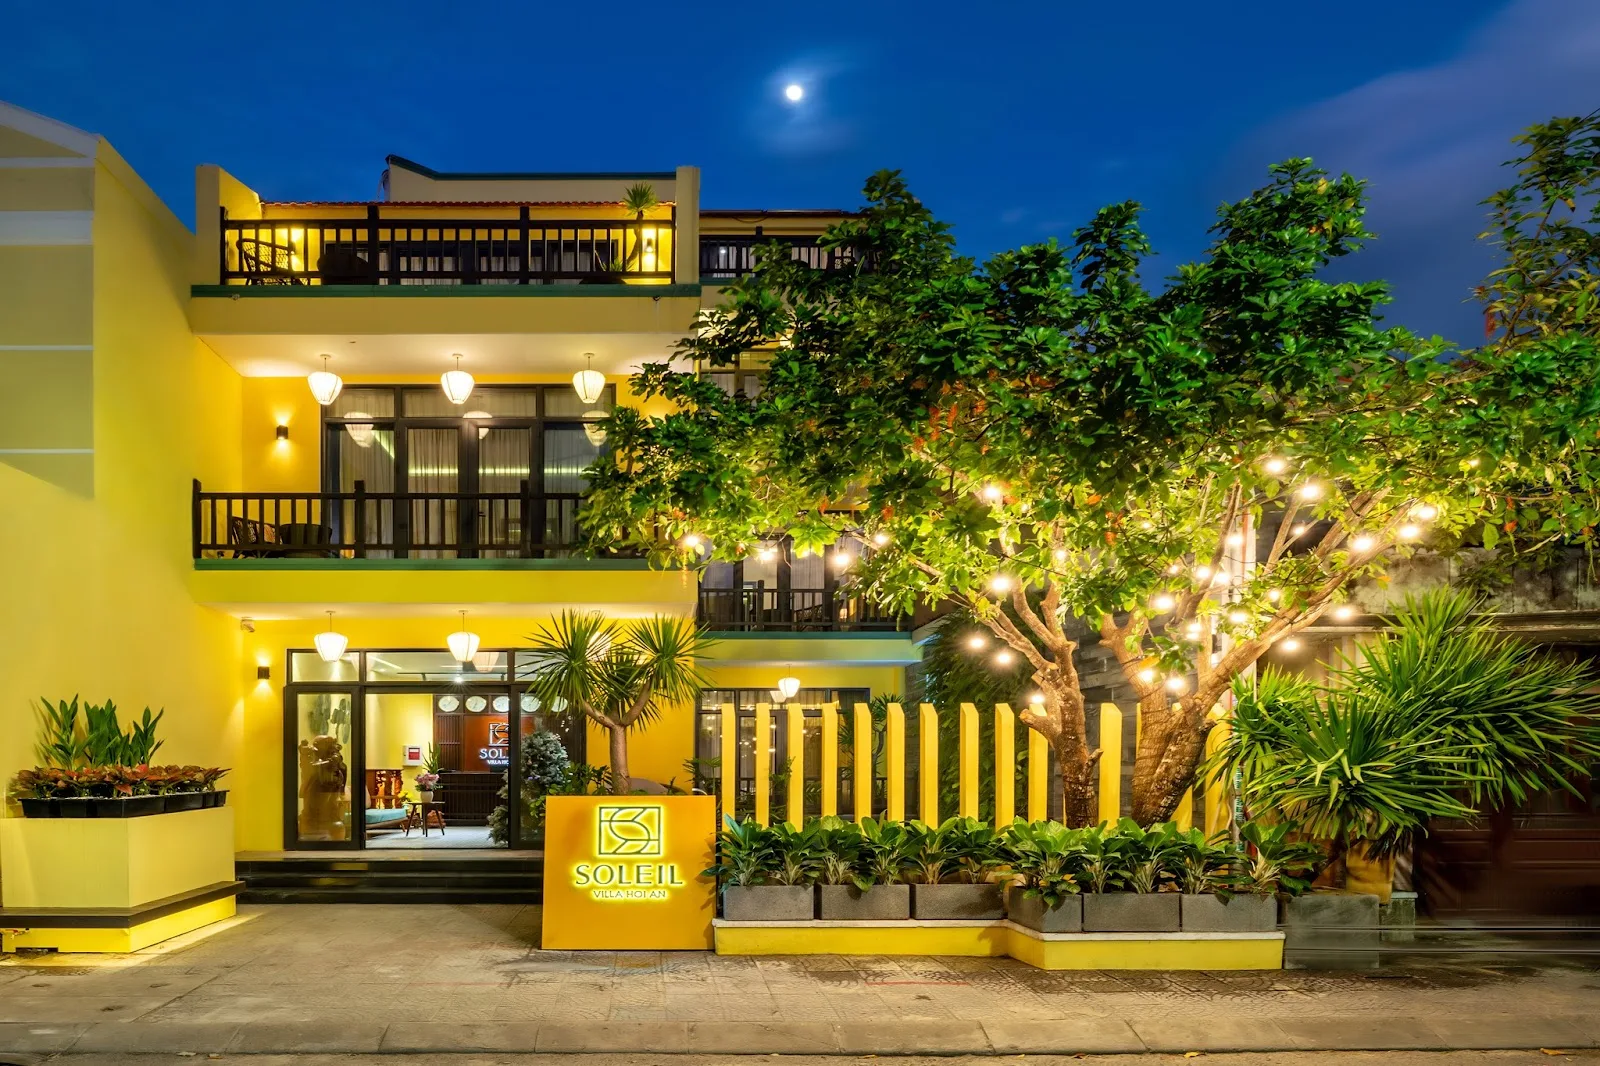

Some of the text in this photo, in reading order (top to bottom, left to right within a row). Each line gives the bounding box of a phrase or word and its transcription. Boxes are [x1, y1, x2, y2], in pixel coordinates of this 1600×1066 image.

[479, 748, 509, 760] SOL
[575, 864, 683, 885] SOLEIL
[593, 890, 666, 898] VILLA HOI AN
